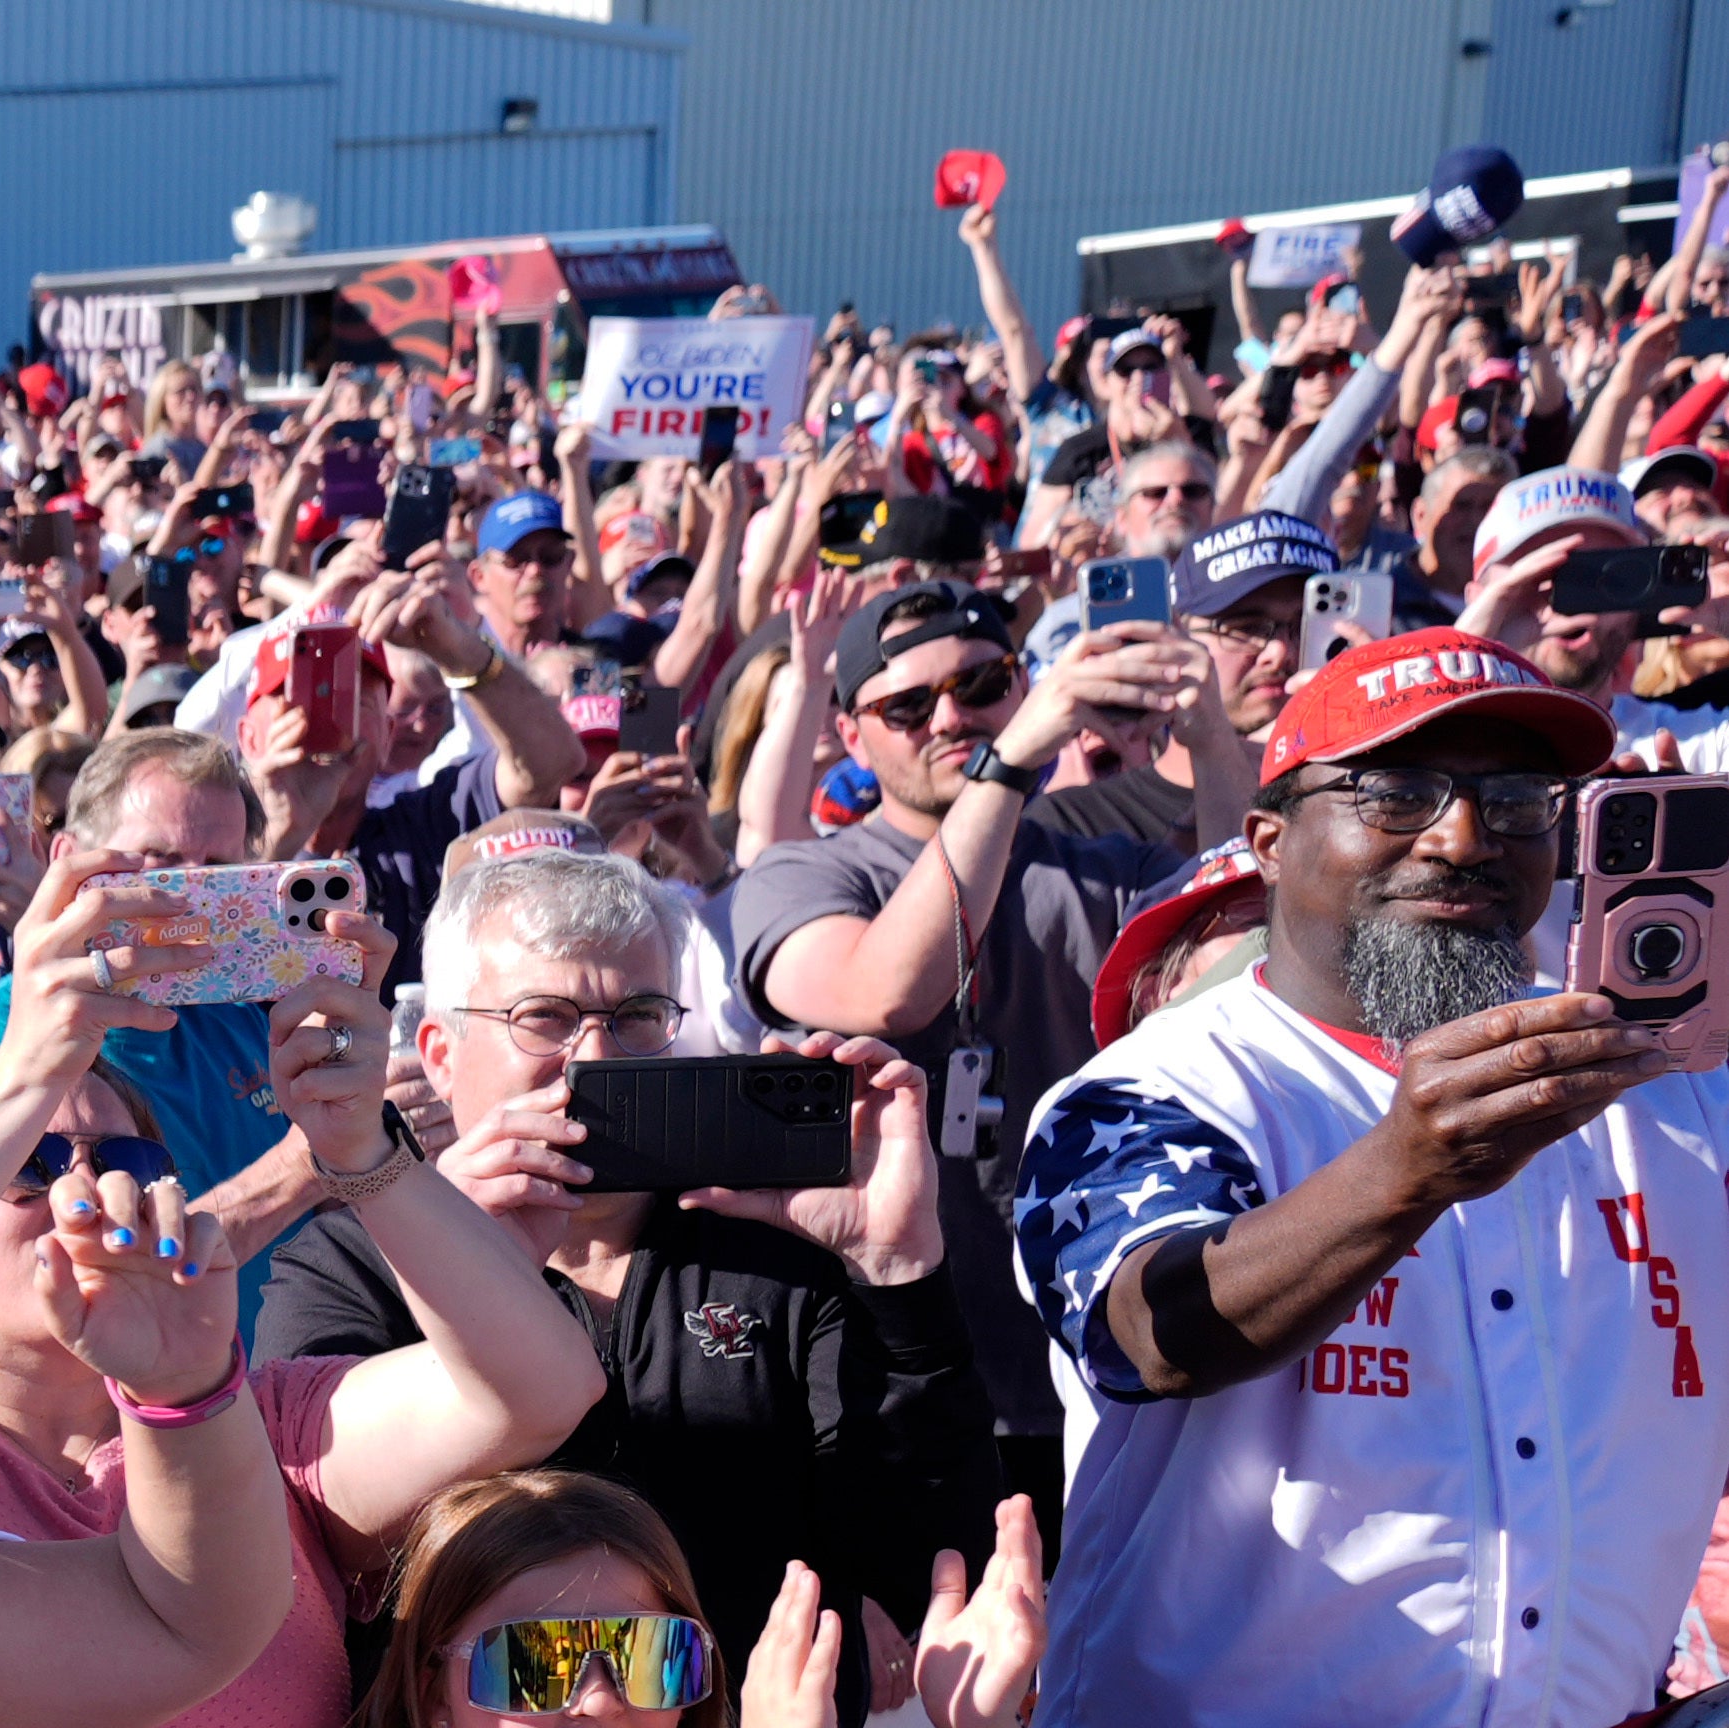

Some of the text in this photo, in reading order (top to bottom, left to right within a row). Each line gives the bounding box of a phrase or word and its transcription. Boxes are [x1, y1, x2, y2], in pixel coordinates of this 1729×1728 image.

[620, 373, 766, 401] YOU'RE
[1517, 477, 1619, 511] TRUMP
[1192, 519, 1256, 563] MAKE
[1207, 543, 1277, 583] GREAT
[474, 826, 576, 860] Trump
[159, 921, 204, 941] loopy
[1596, 1192, 1704, 1398] USA
